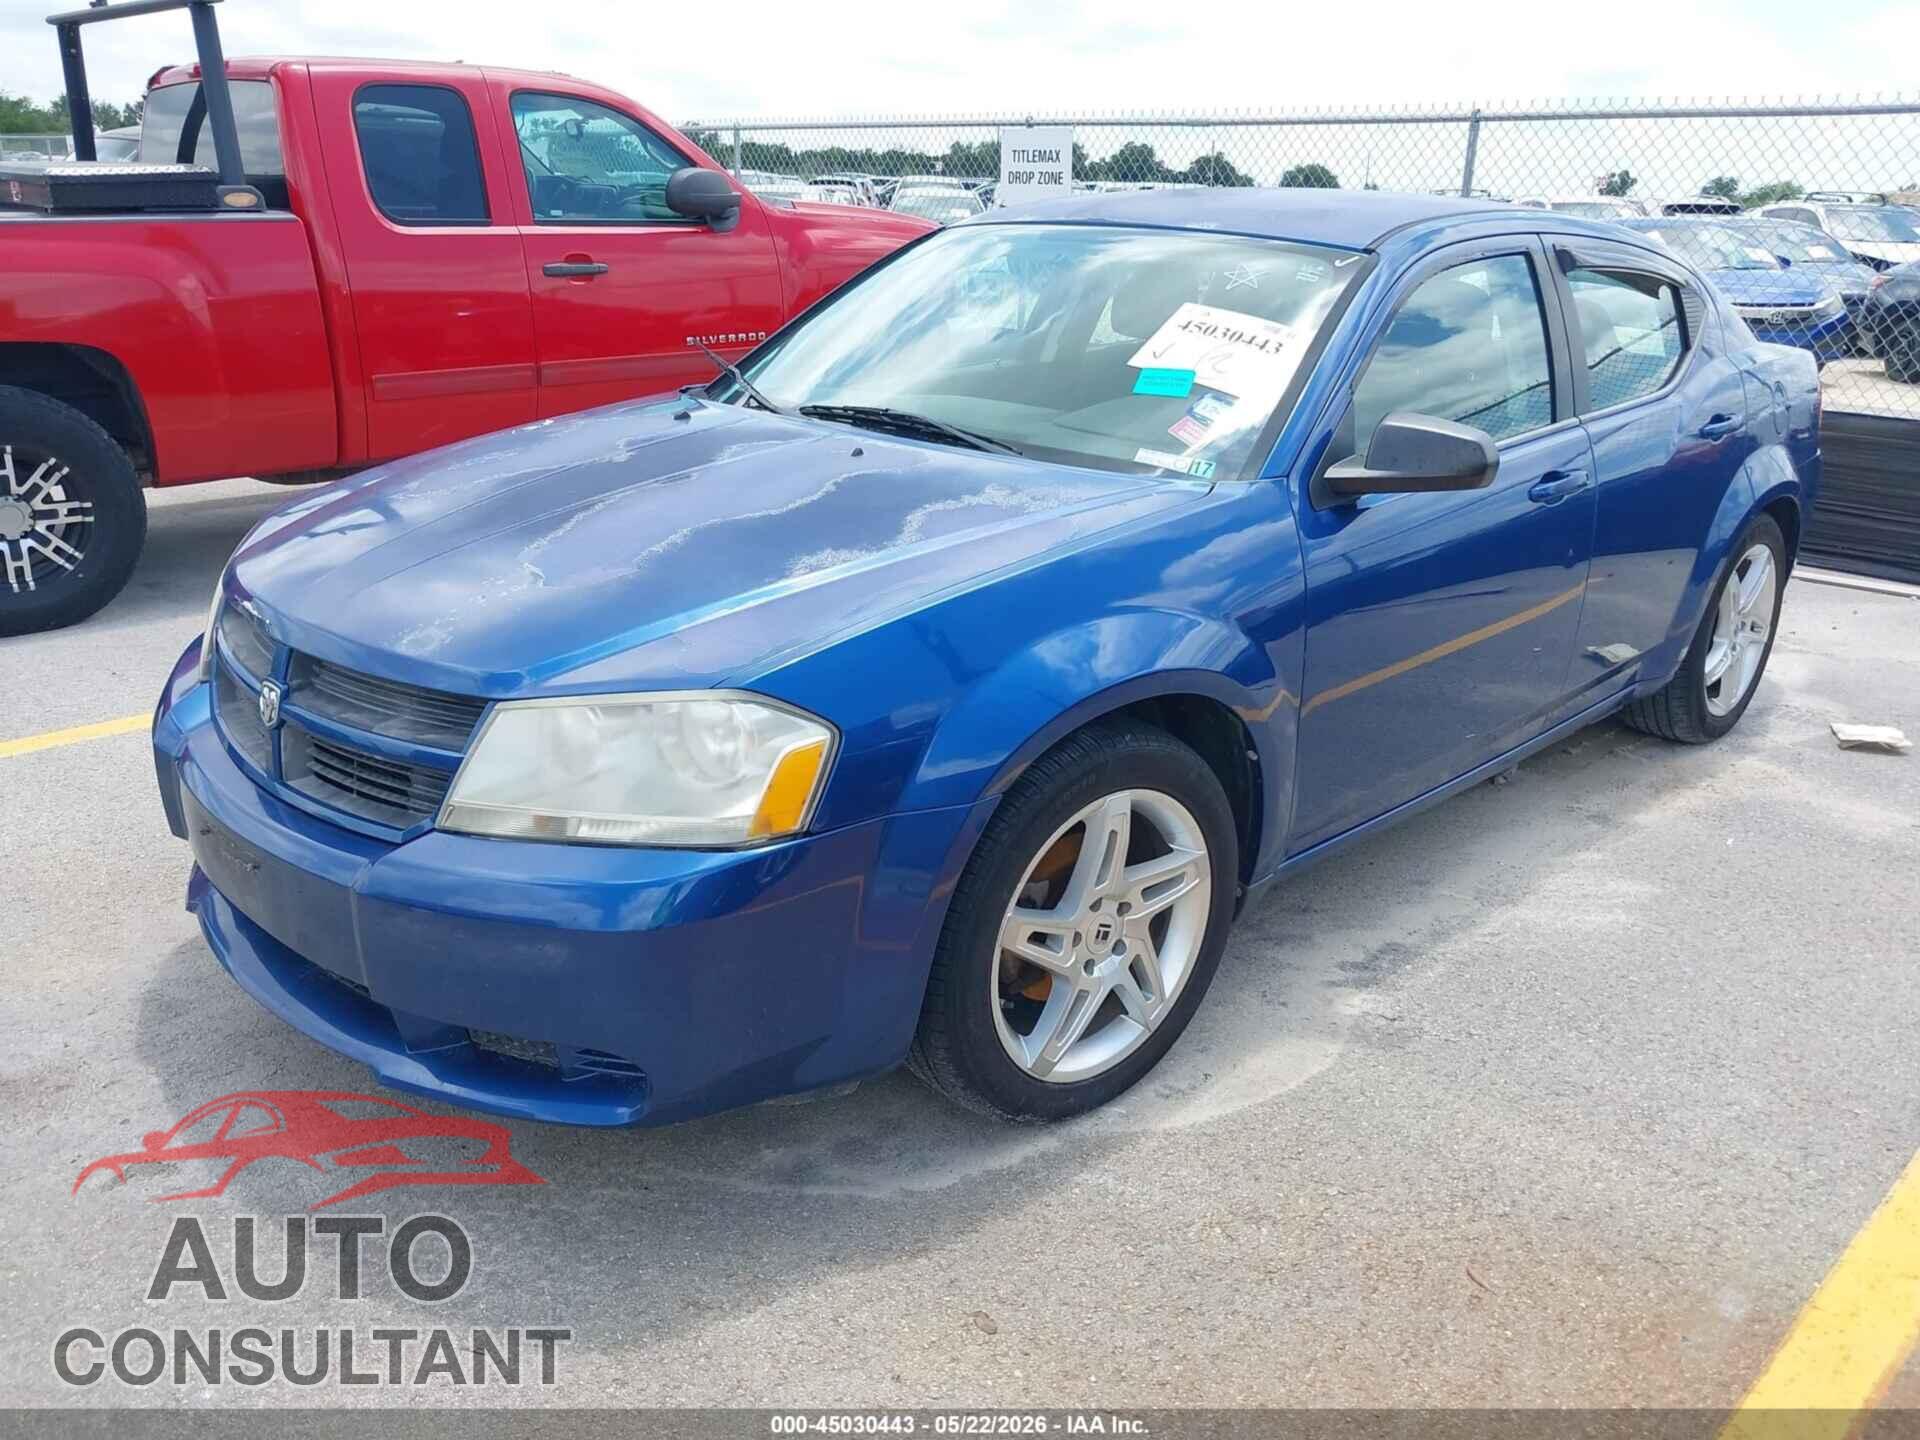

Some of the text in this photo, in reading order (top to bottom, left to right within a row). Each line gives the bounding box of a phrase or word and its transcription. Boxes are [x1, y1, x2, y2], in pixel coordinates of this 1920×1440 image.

[1011, 149, 1061, 163] TITLEMAX
[1007, 171, 1064, 185] DROP ZONE
[686, 331, 767, 346] SILVERADO
[1177, 320, 1283, 354] 45030443
[1194, 461, 1213, 476] 17
